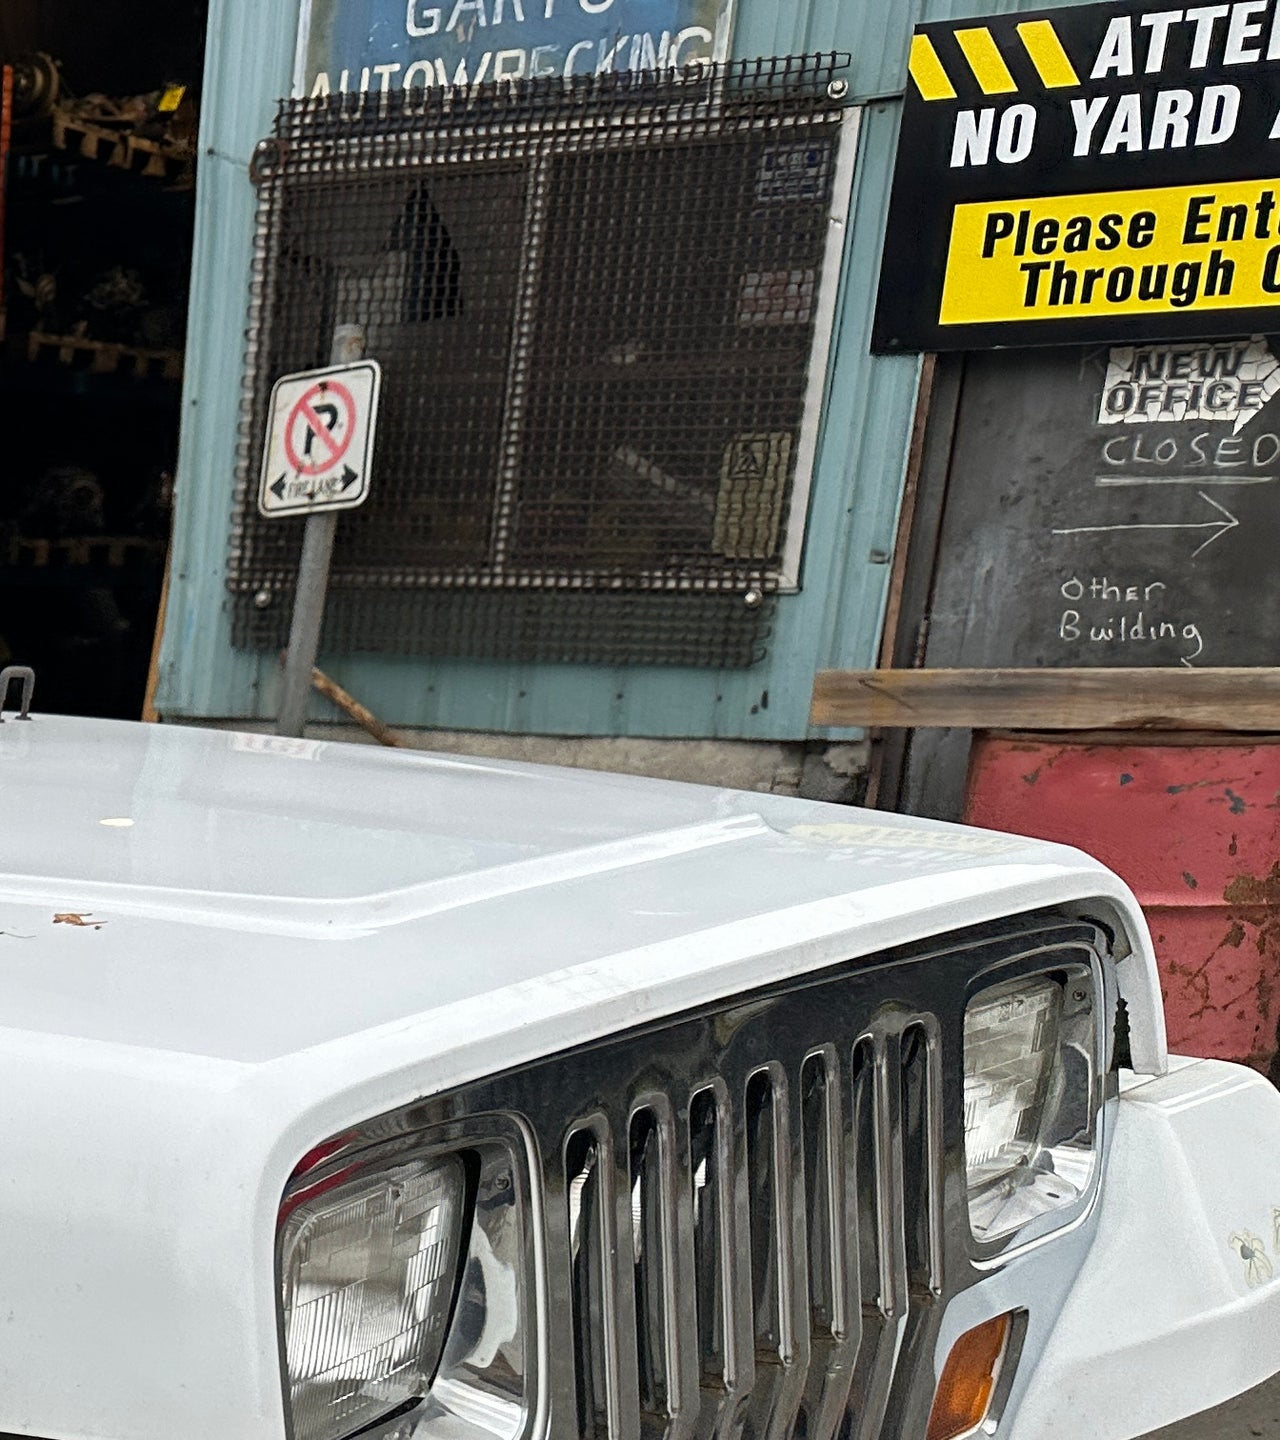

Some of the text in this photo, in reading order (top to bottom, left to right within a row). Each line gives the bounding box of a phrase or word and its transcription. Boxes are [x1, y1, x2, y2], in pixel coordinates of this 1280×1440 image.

[950, 104, 1037, 168] NO
[1071, 84, 1241, 157] YARD
[981, 190, 1280, 259] Please Ent
[1020, 249, 1236, 308] Through
[1134, 347, 1243, 379] NEW
[1106, 380, 1265, 414] OFFICE
[1103, 432, 1280, 468] CLOSED
[1059, 609, 1203, 667] Building
